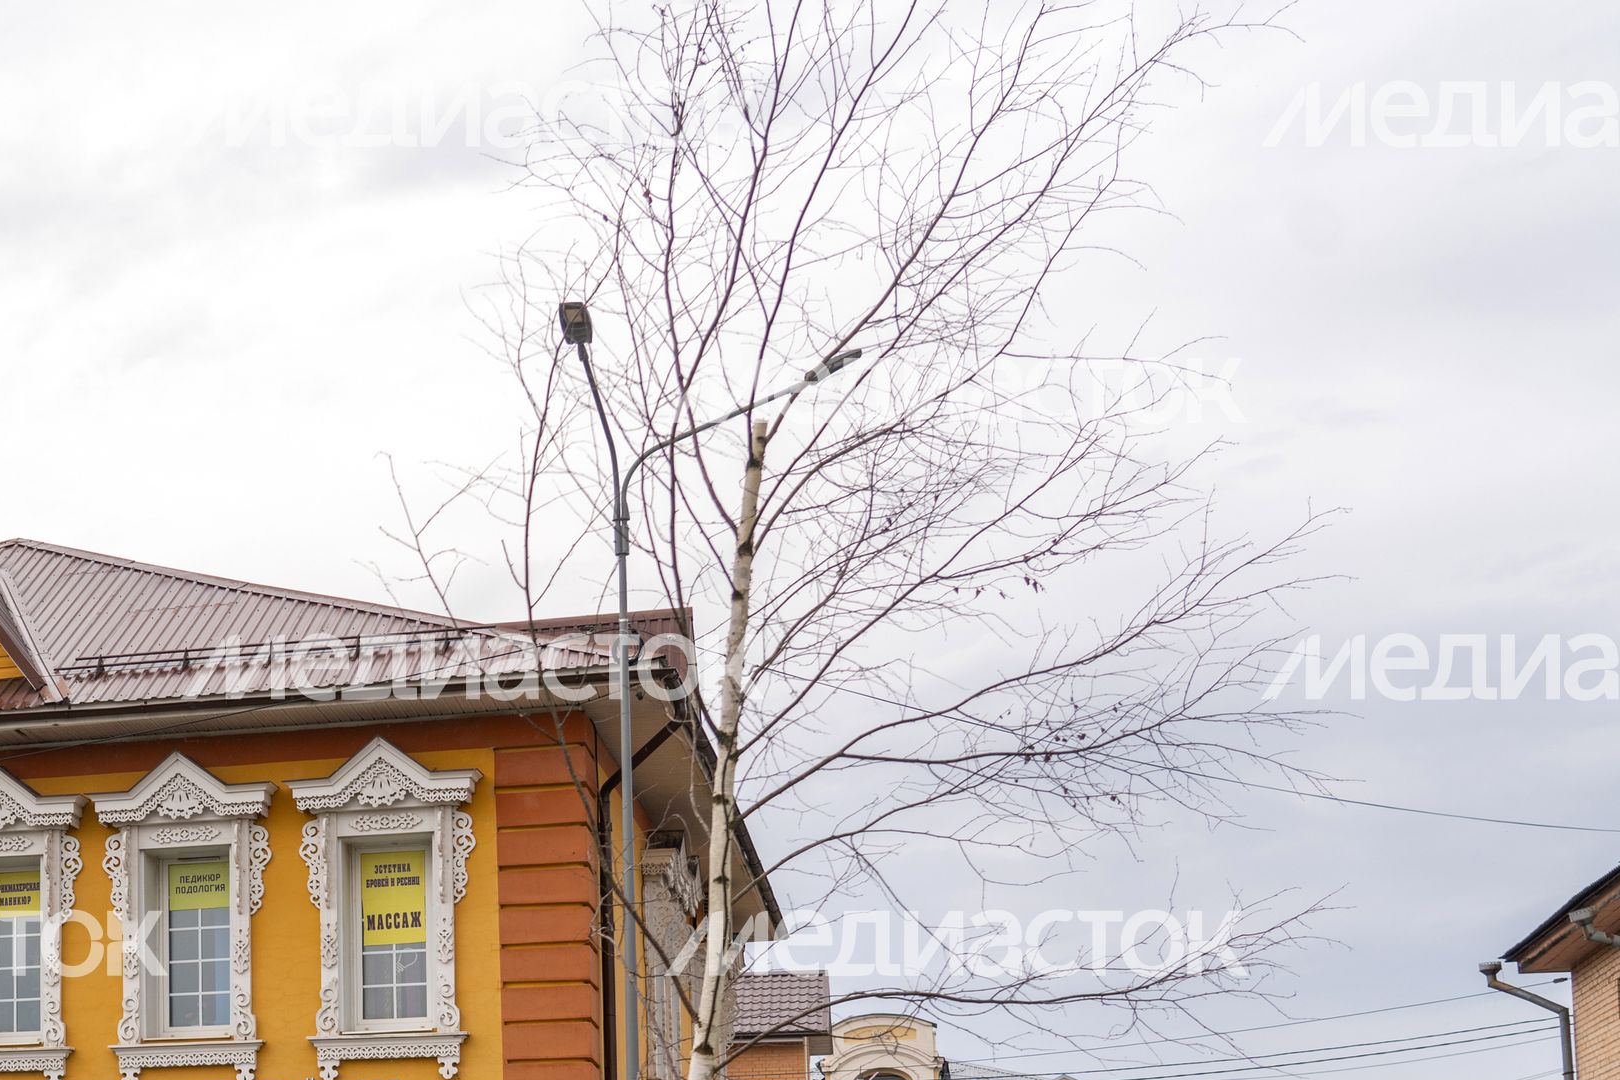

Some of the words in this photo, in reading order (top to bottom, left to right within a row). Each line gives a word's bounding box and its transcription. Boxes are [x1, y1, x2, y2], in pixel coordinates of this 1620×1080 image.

[374, 863, 411, 874] ЭСТЕТИКА
[179, 874, 221, 884] ПЕДИКЮР
[366, 876, 389, 888] БРОВЕЙ
[390, 878, 395, 886] И
[396, 876, 420, 886] РЕСНИЦ
[175, 884, 226, 895] ПОДОЛОГИЯ
[0, 896, 32, 906] МАНИКЮР
[367, 911, 422, 931] МАССАЖ
